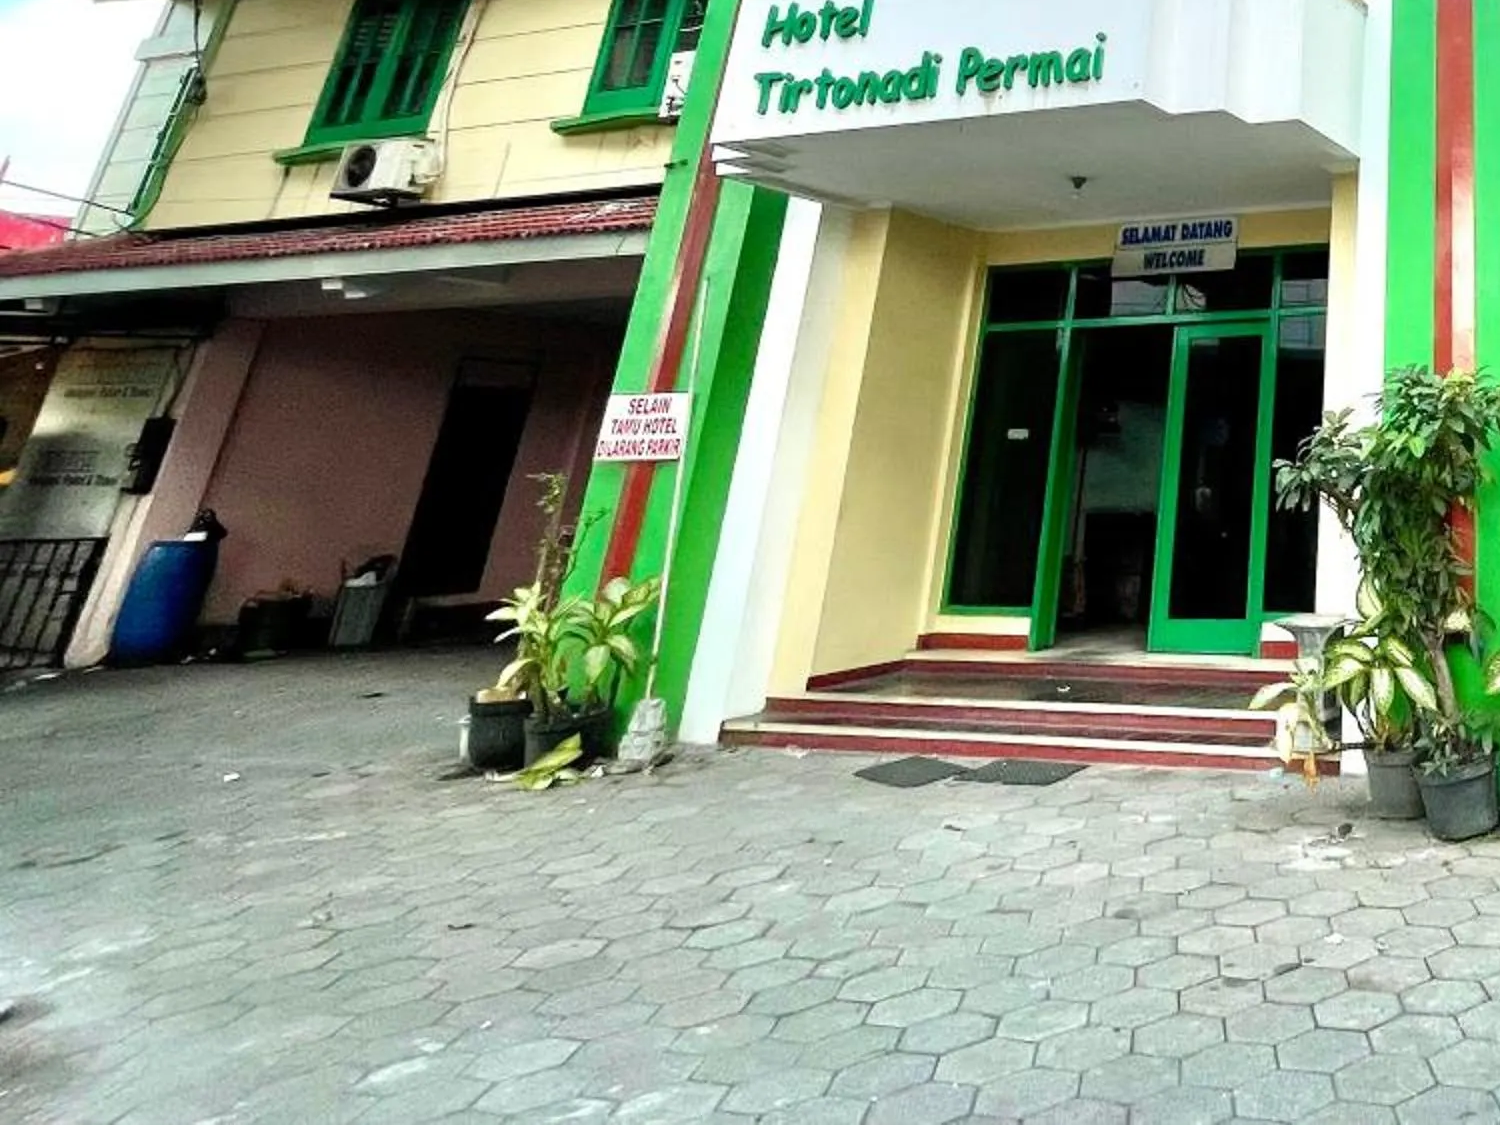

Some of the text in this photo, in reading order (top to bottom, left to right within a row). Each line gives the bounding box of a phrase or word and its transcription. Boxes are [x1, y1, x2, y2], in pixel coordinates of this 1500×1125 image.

[754, 31, 1107, 115] Tirtonadi Permai
[1122, 220, 1233, 245] SELAMAT DATANG
[1143, 249, 1206, 270] WELCOME
[628, 397, 673, 414] SELAIN
[611, 417, 676, 435] TAMU HOTEL
[597, 439, 645, 457] DILARANG
